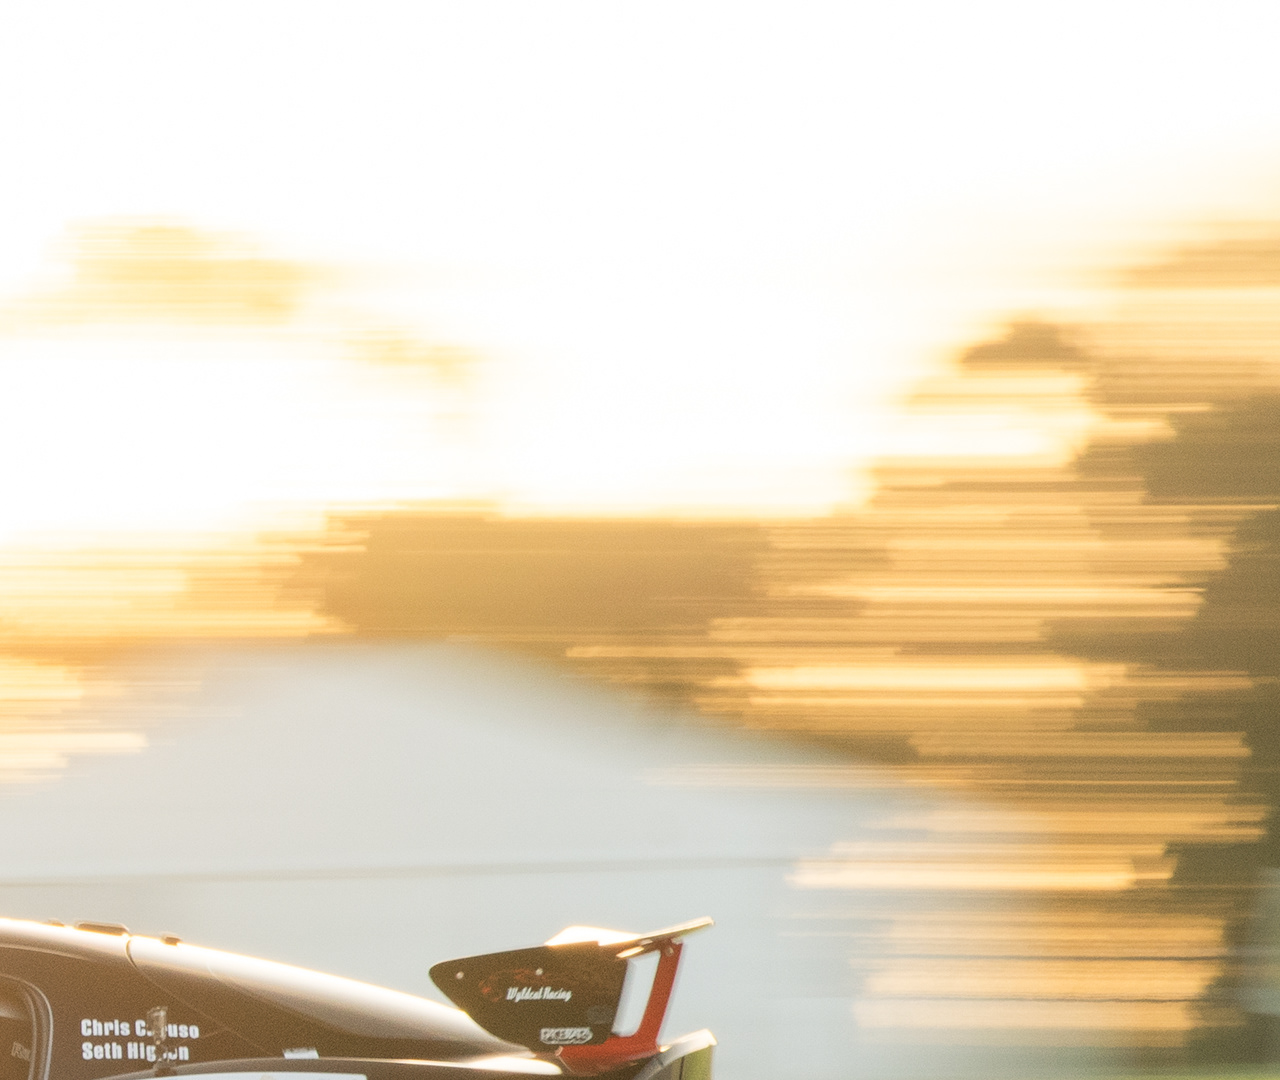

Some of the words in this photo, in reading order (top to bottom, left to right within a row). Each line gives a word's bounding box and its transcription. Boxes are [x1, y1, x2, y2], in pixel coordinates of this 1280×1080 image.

[543, 986, 572, 1002] Racing
[81, 1018, 130, 1037] Chris
[82, 1041, 123, 1060] Seth
